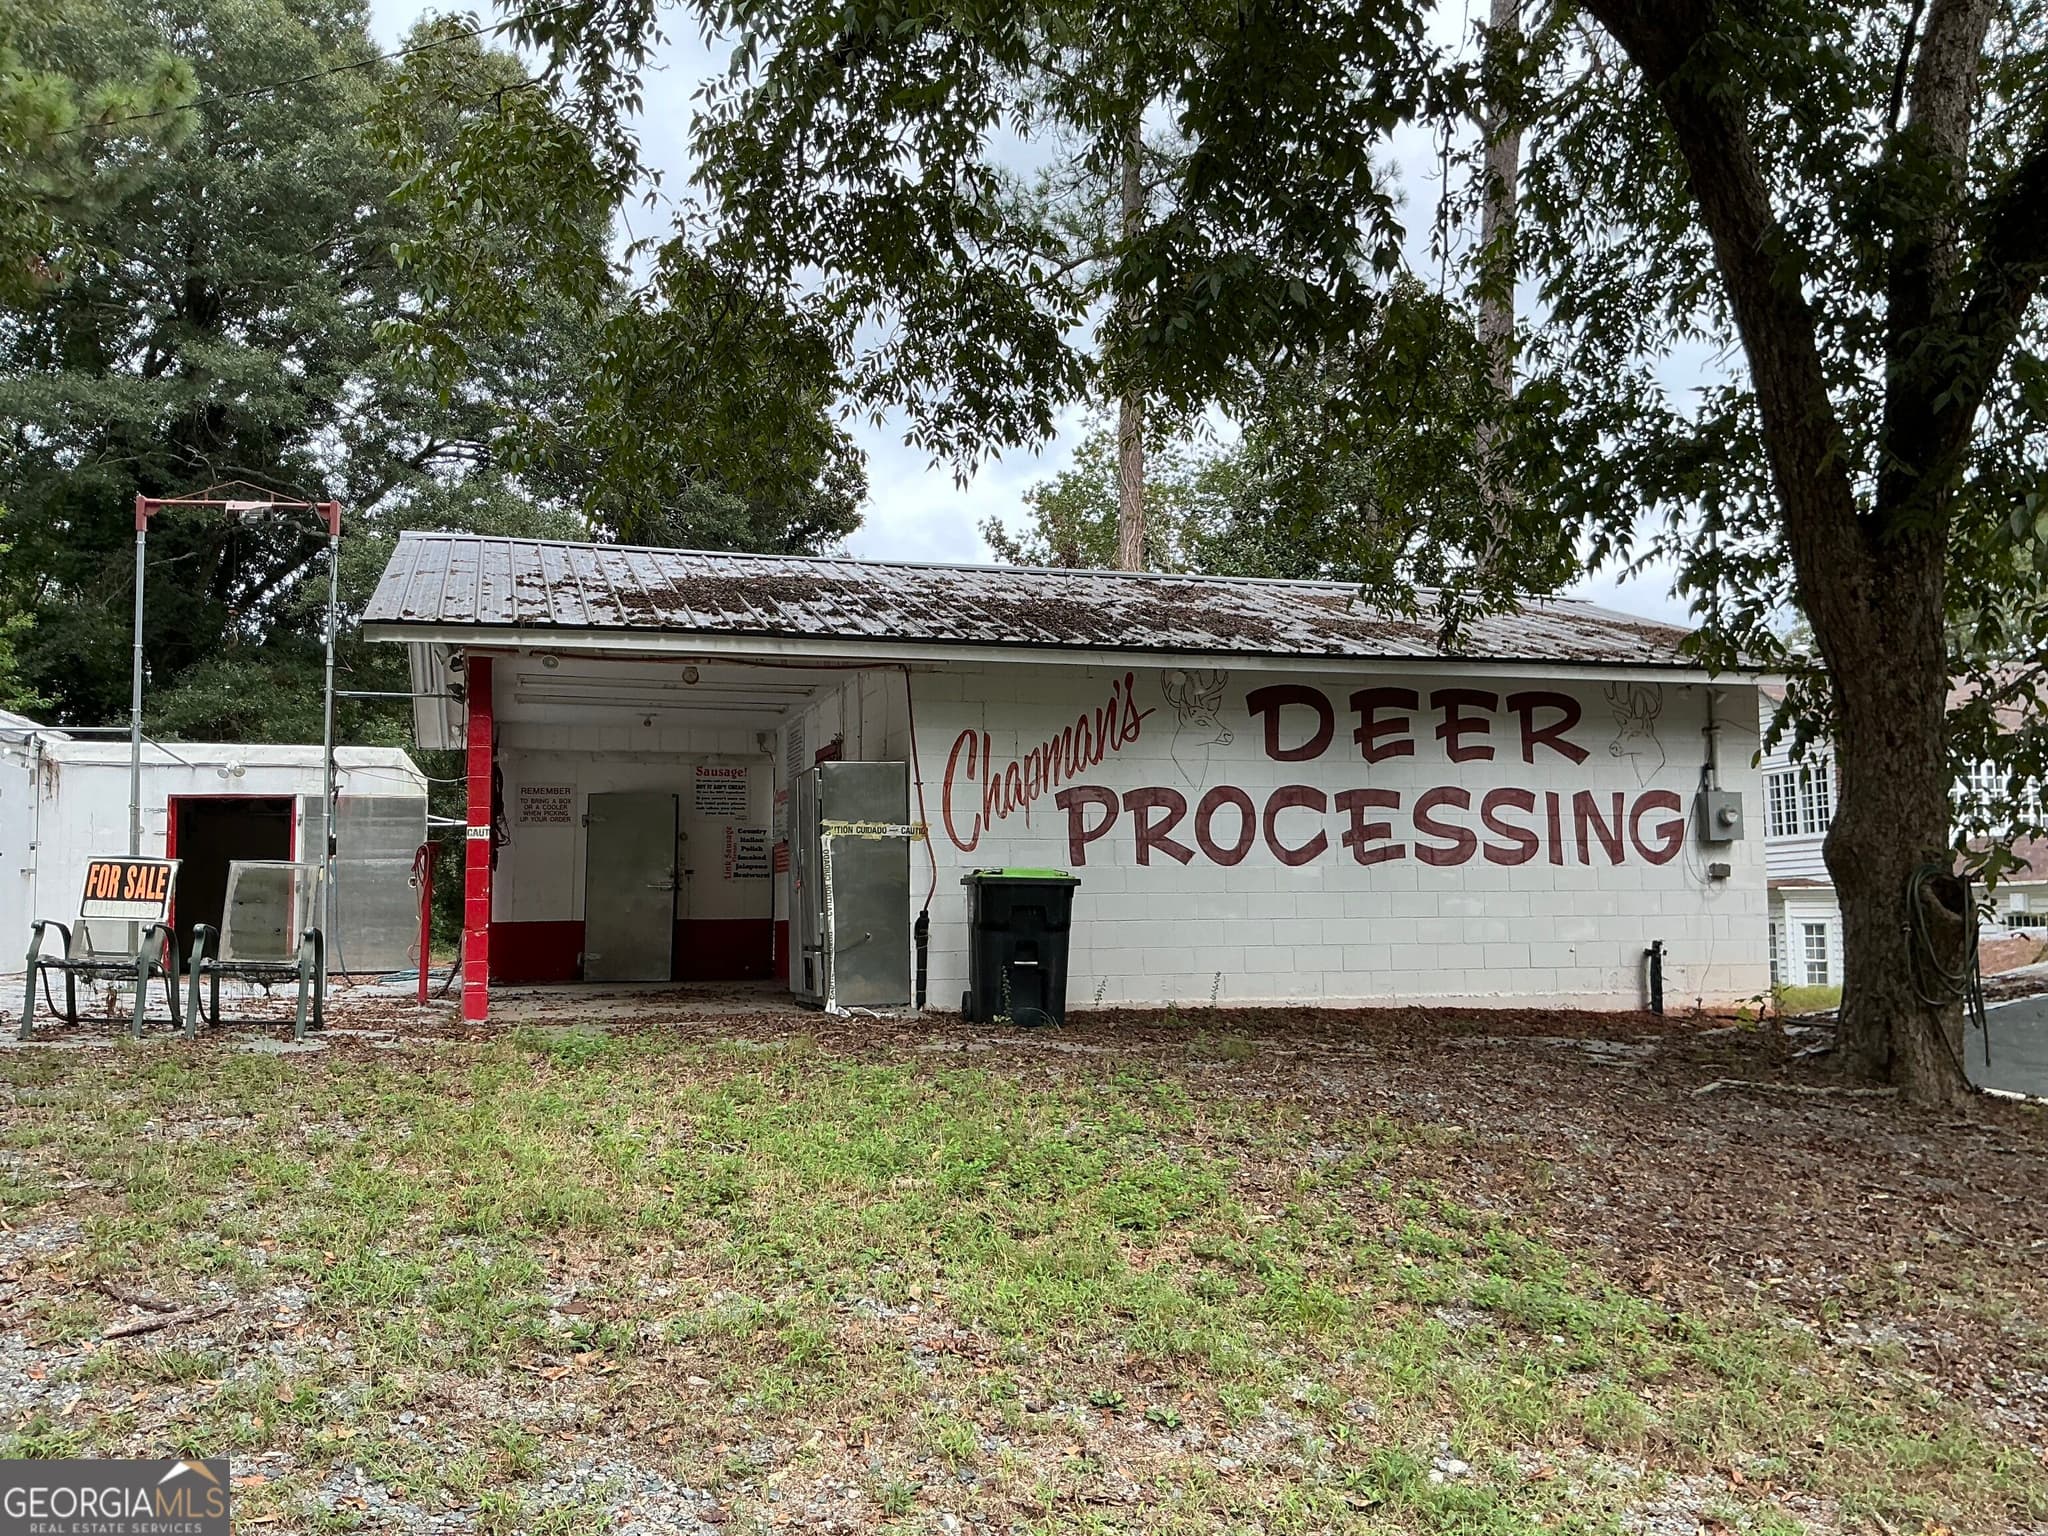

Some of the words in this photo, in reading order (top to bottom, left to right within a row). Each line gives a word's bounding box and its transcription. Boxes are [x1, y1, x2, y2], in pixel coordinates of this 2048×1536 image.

[1246, 684, 1590, 765] DEER
[696, 766, 747, 778] Sausage!
[942, 672, 1156, 852] Chapman's
[520, 787, 571, 795] REMEMBER
[738, 828, 767, 836] Country
[856, 826, 887, 834] CUIDADO
[1055, 784, 1684, 866] PROCESSING
[86, 864, 121, 898] FOR
[124, 865, 169, 900] SALE
